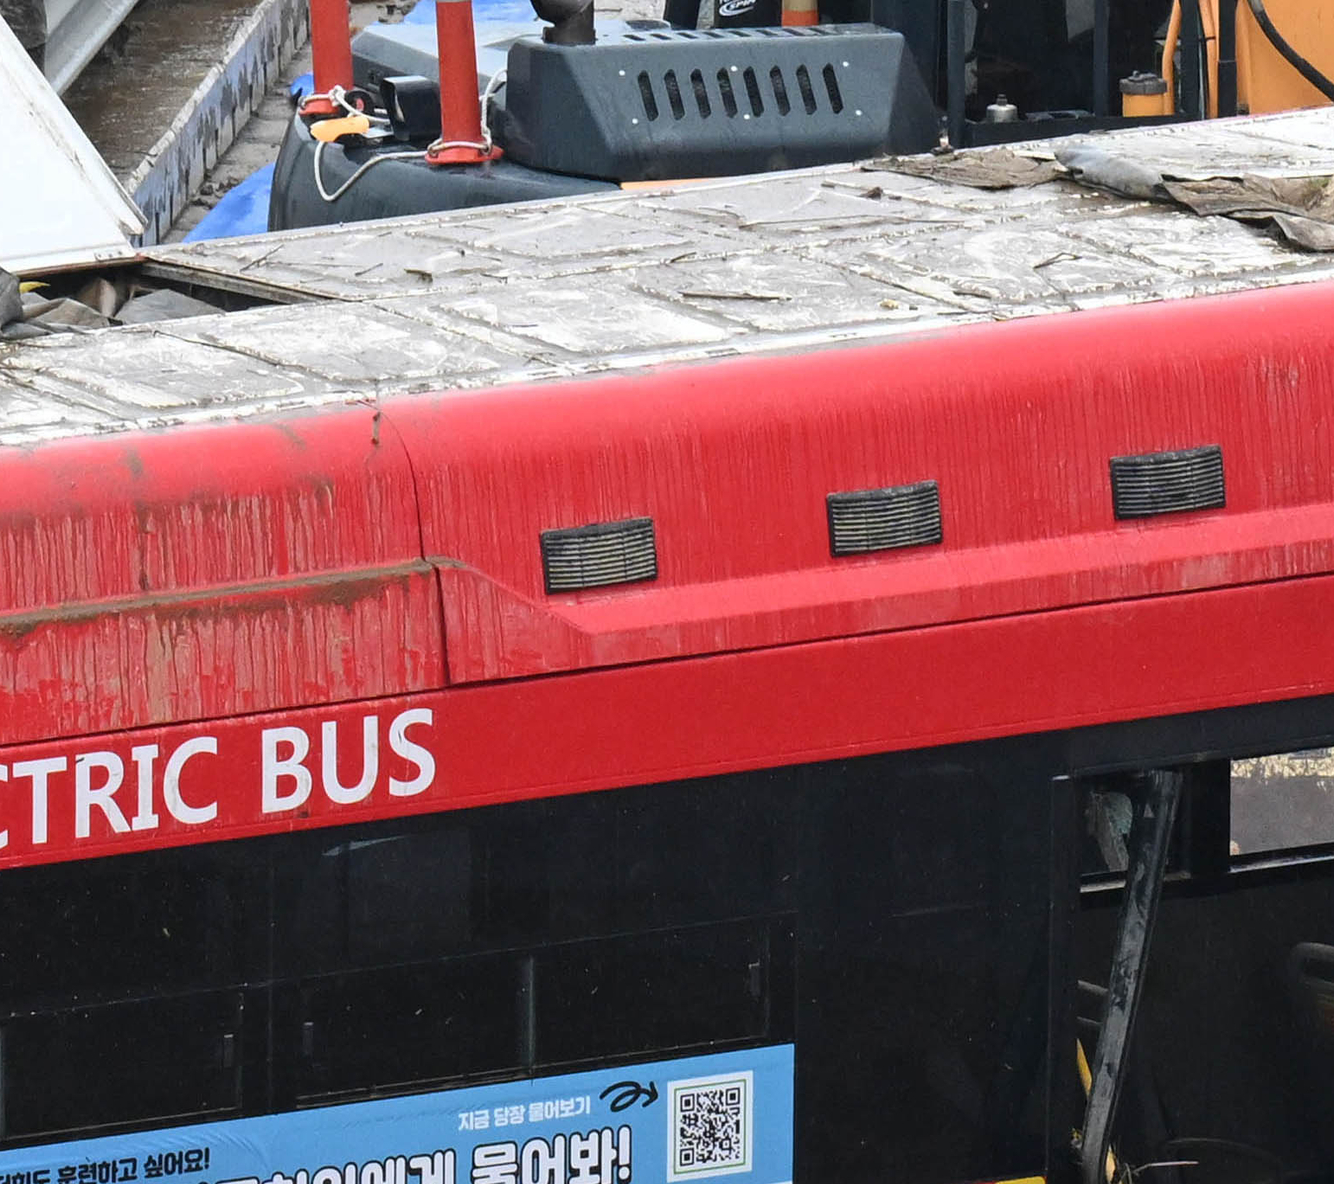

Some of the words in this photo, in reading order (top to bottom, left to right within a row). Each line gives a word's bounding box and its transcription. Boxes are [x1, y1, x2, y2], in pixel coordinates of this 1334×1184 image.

[261, 709, 434, 814] BUS
[458, 1112, 489, 1131] 지금
[494, 1105, 525, 1127] 당장
[529, 1096, 591, 1122] 물어보기
[144, 1147, 210, 1177] 싶어요!
